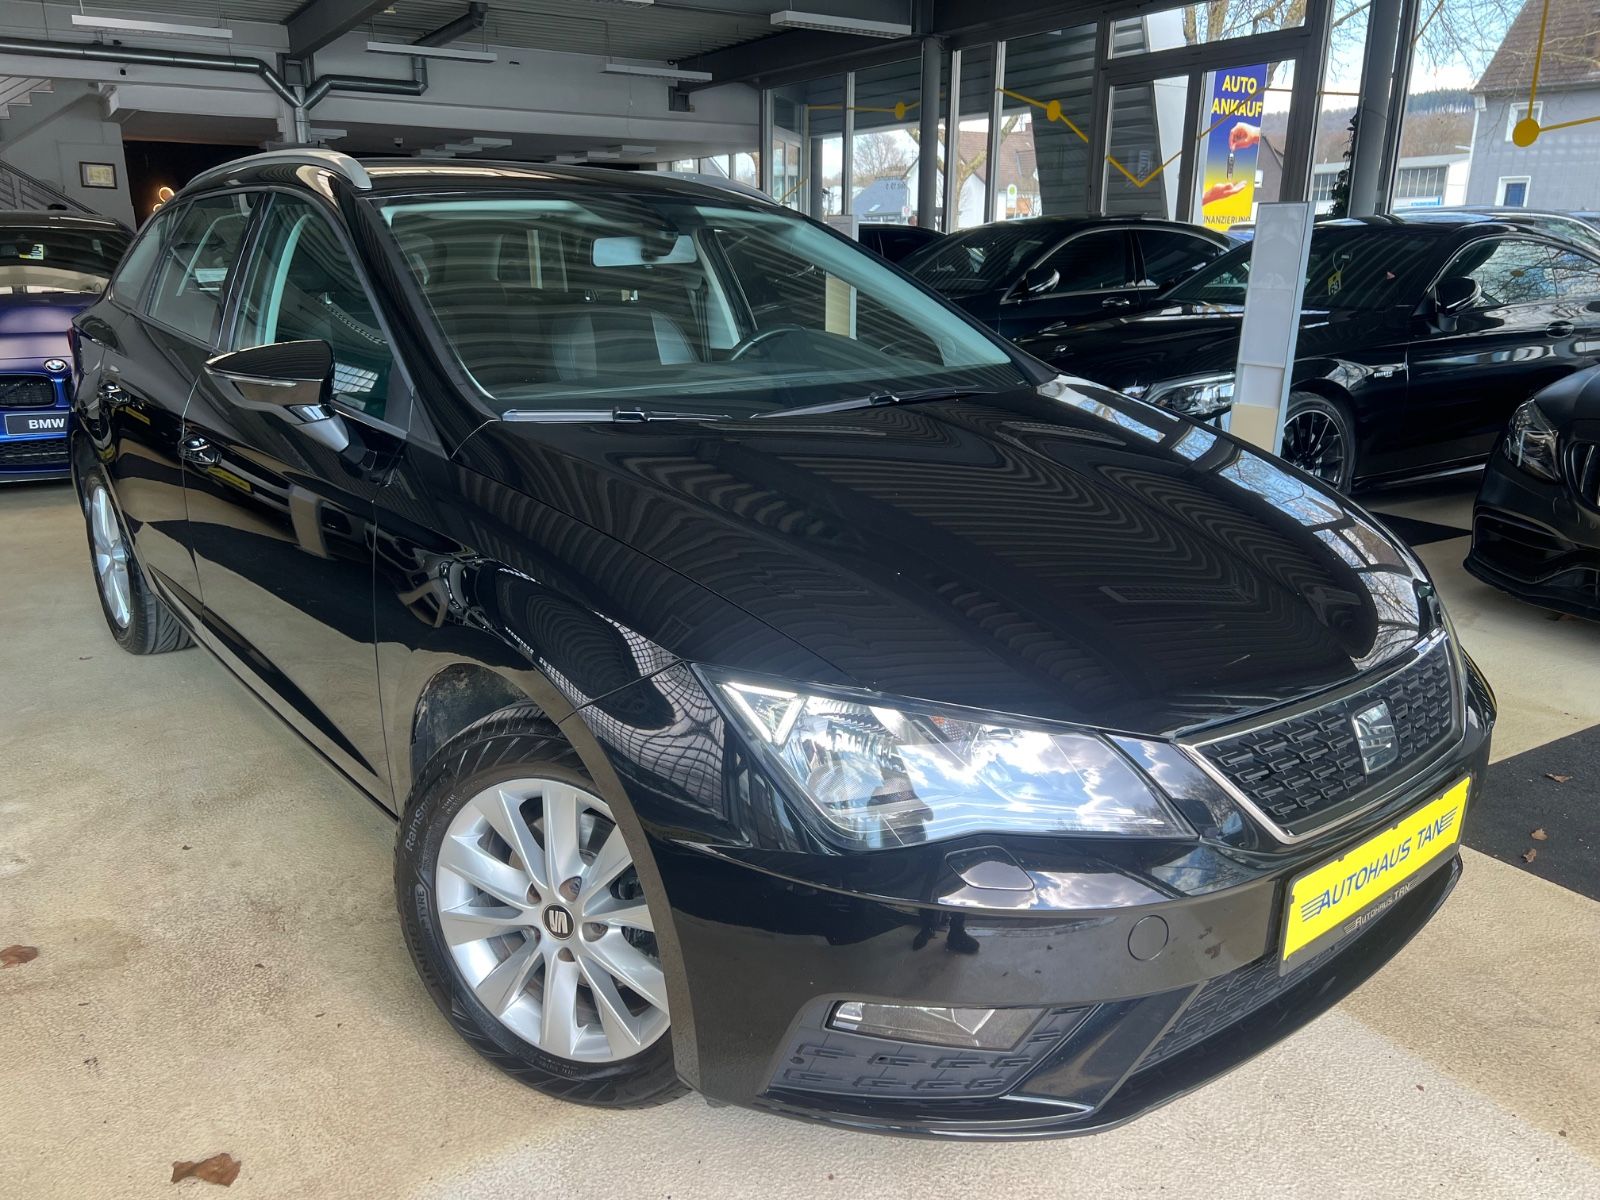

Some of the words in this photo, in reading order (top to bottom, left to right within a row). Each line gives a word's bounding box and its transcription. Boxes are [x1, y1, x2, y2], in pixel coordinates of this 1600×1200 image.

[1221, 74, 1257, 94] AUTO
[1211, 97, 1263, 118] ANKAUF
[28, 418, 65, 429] BMW
[1315, 836, 1412, 915] AUTOHAUS
[1417, 814, 1444, 850] TAN
